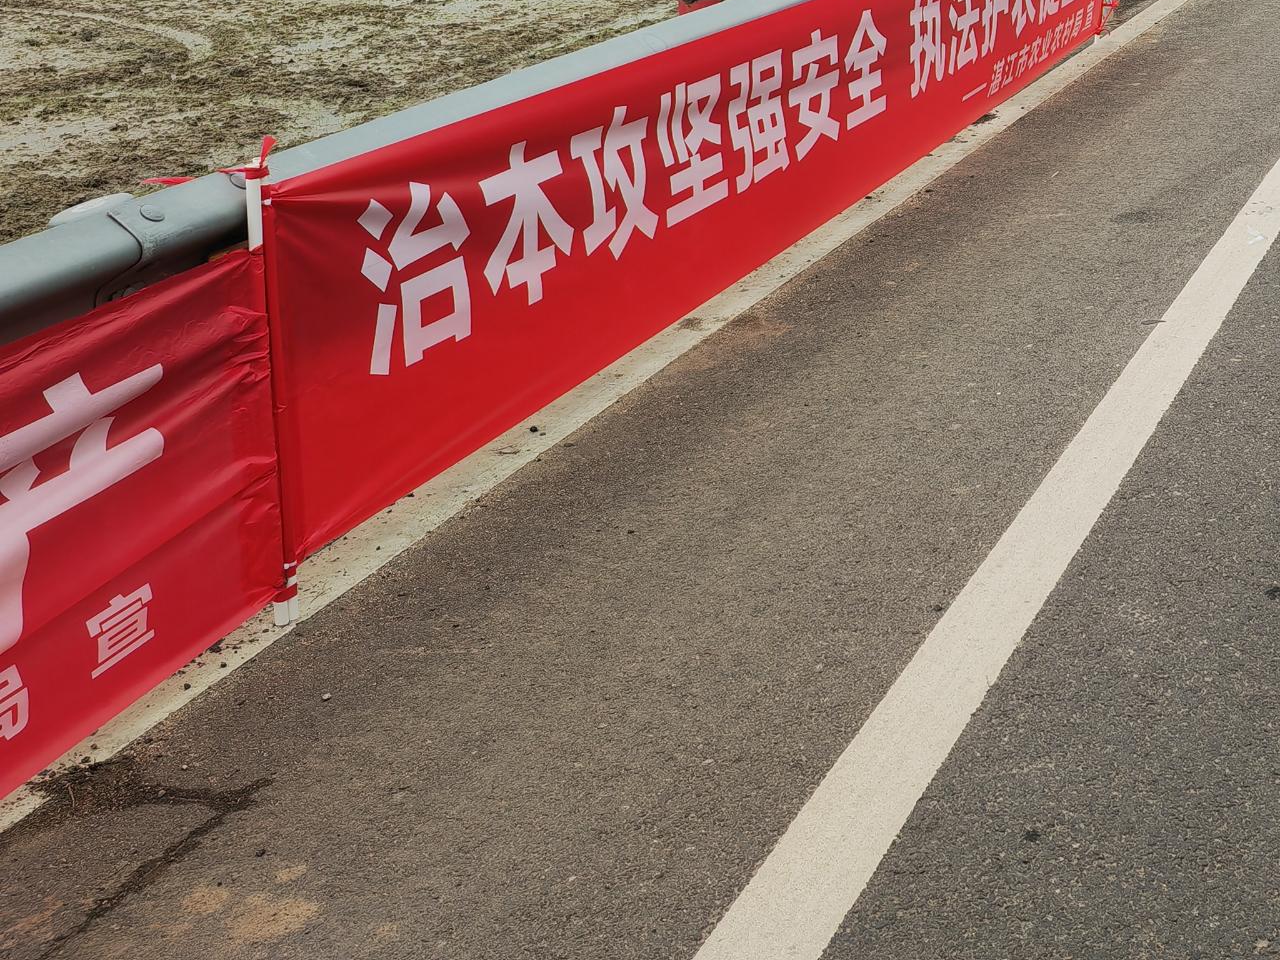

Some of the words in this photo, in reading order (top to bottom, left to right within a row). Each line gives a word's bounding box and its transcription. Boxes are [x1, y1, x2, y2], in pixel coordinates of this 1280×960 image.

[357, 9, 888, 376] 治本攻坚强安全
[86, 583, 155, 680] 宣
